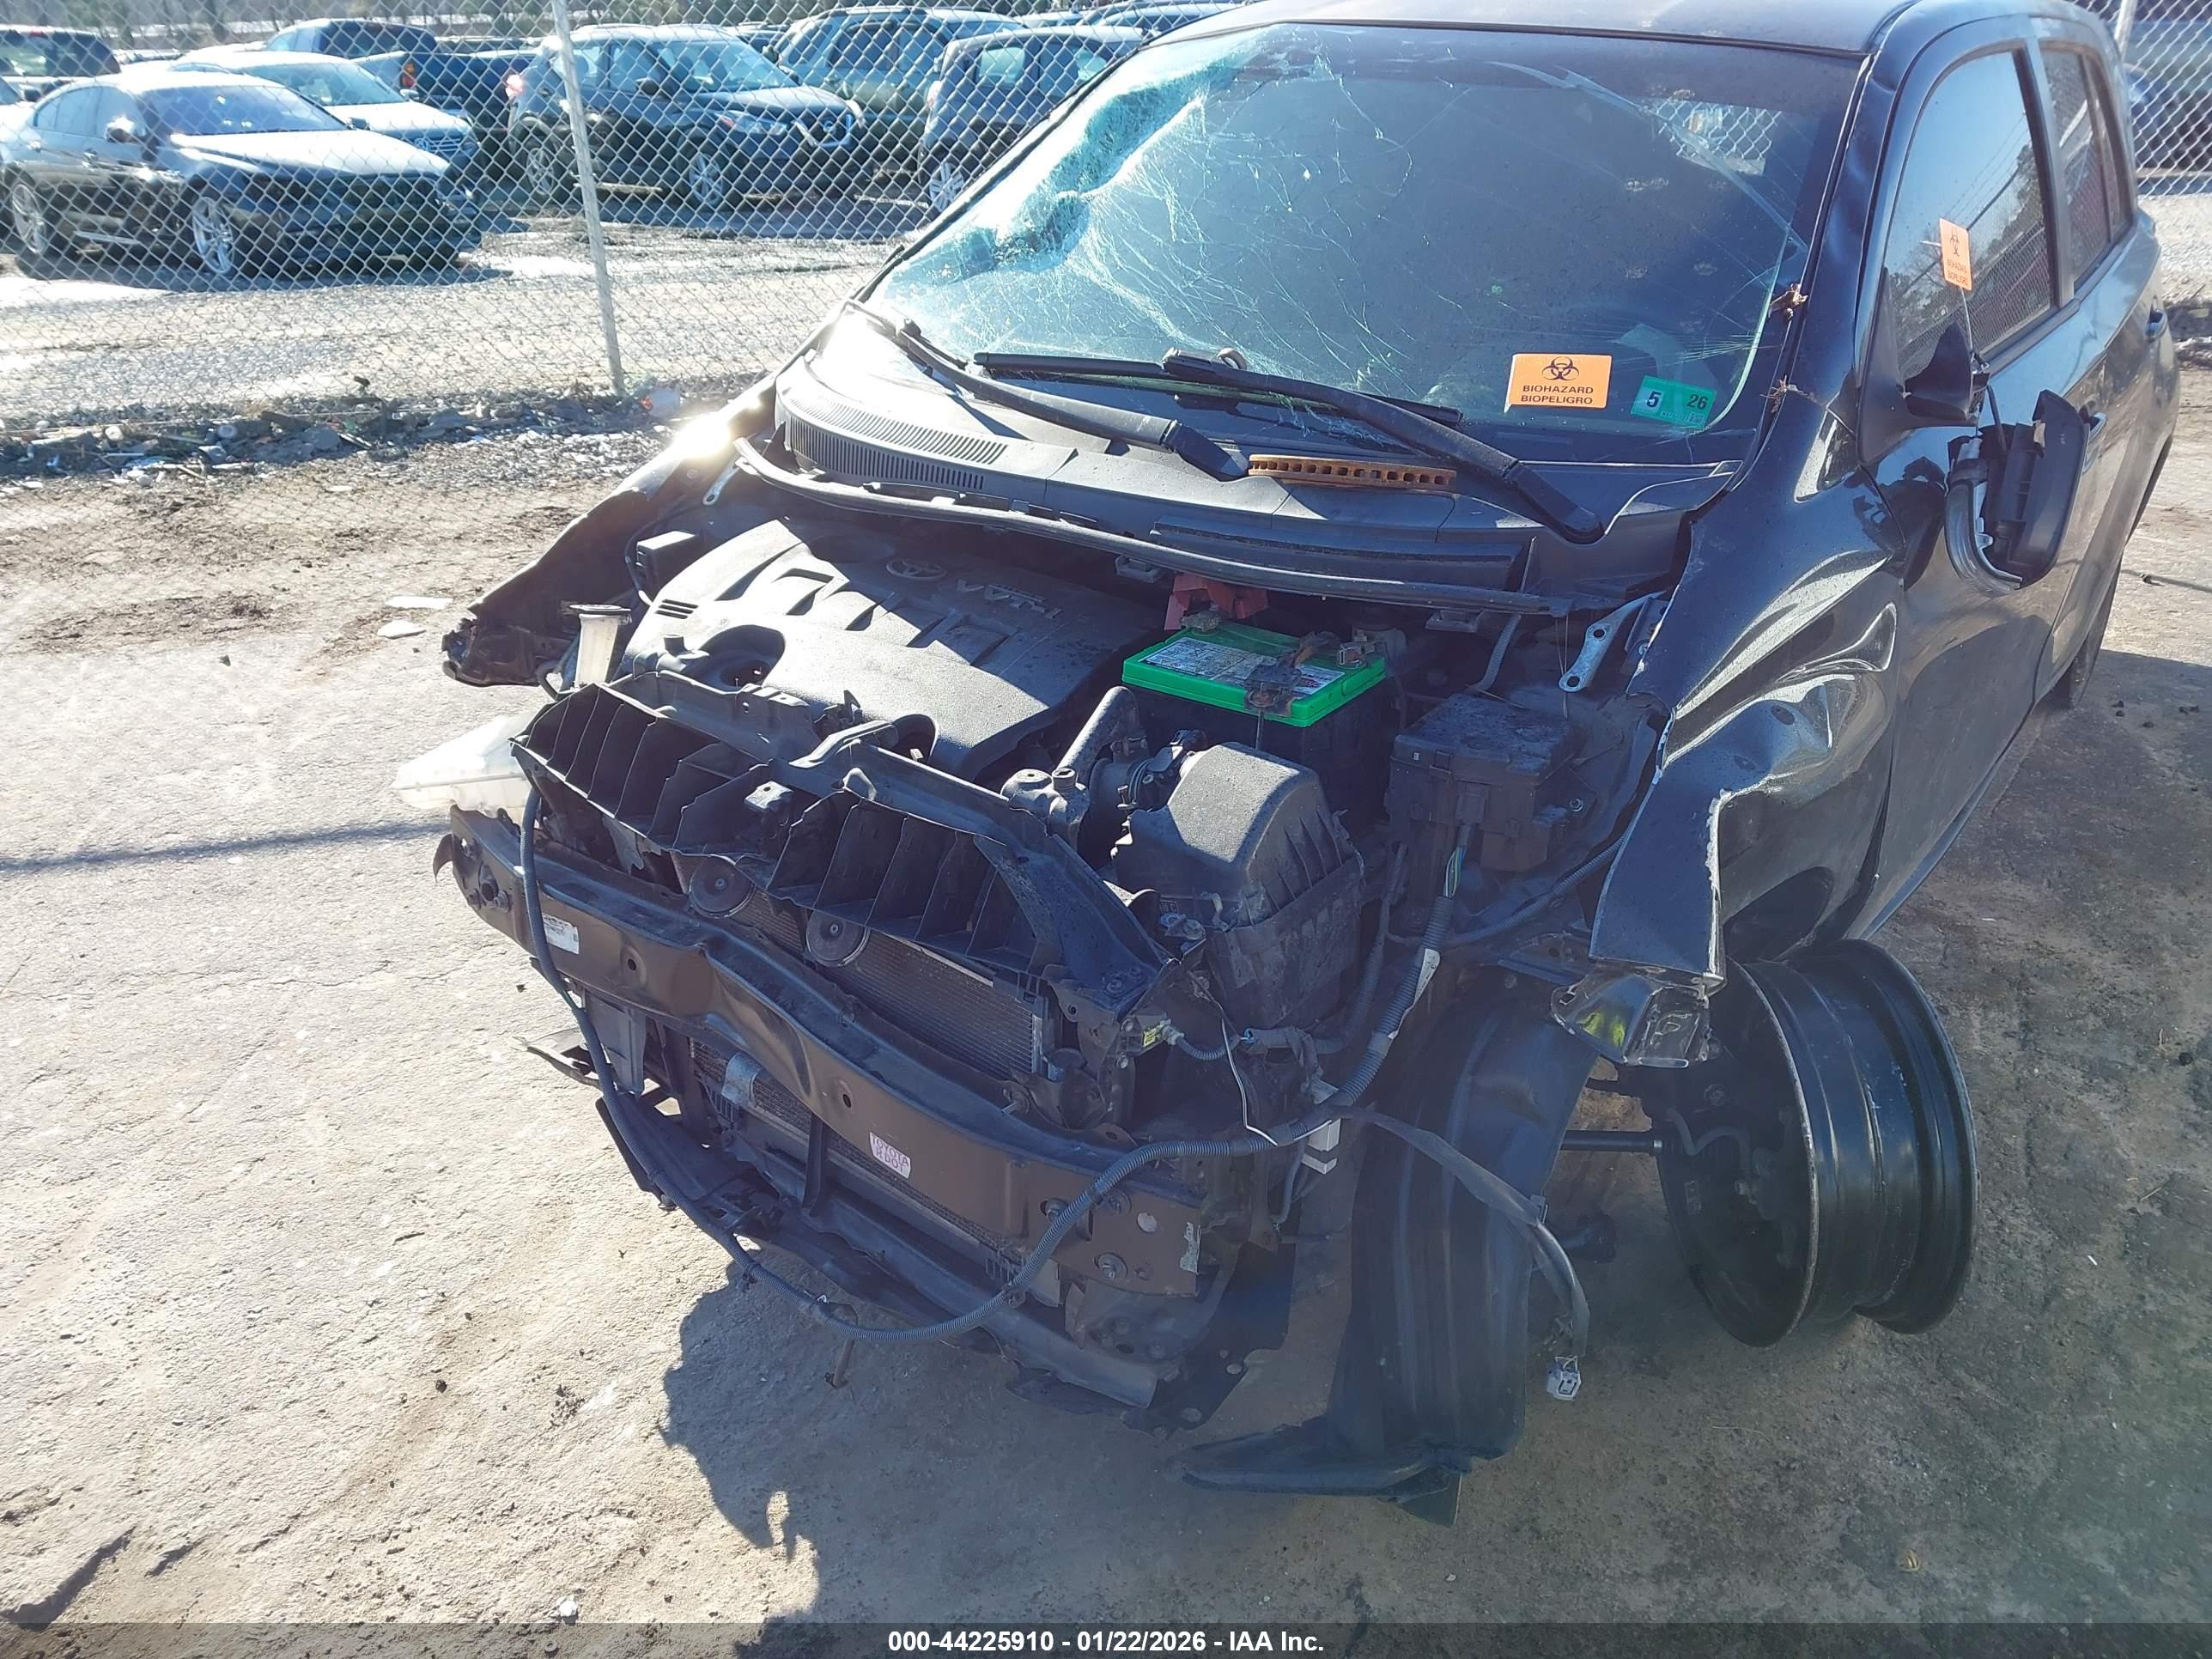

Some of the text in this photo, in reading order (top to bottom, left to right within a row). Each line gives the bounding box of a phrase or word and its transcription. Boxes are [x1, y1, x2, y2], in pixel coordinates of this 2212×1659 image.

[1522, 384, 1595, 394] BIOHAZARD
[1520, 394, 1594, 404] BIOPELIGRO
[1646, 391, 1709, 410] 5 26
[871, 1133, 909, 1167] TOYOTA
